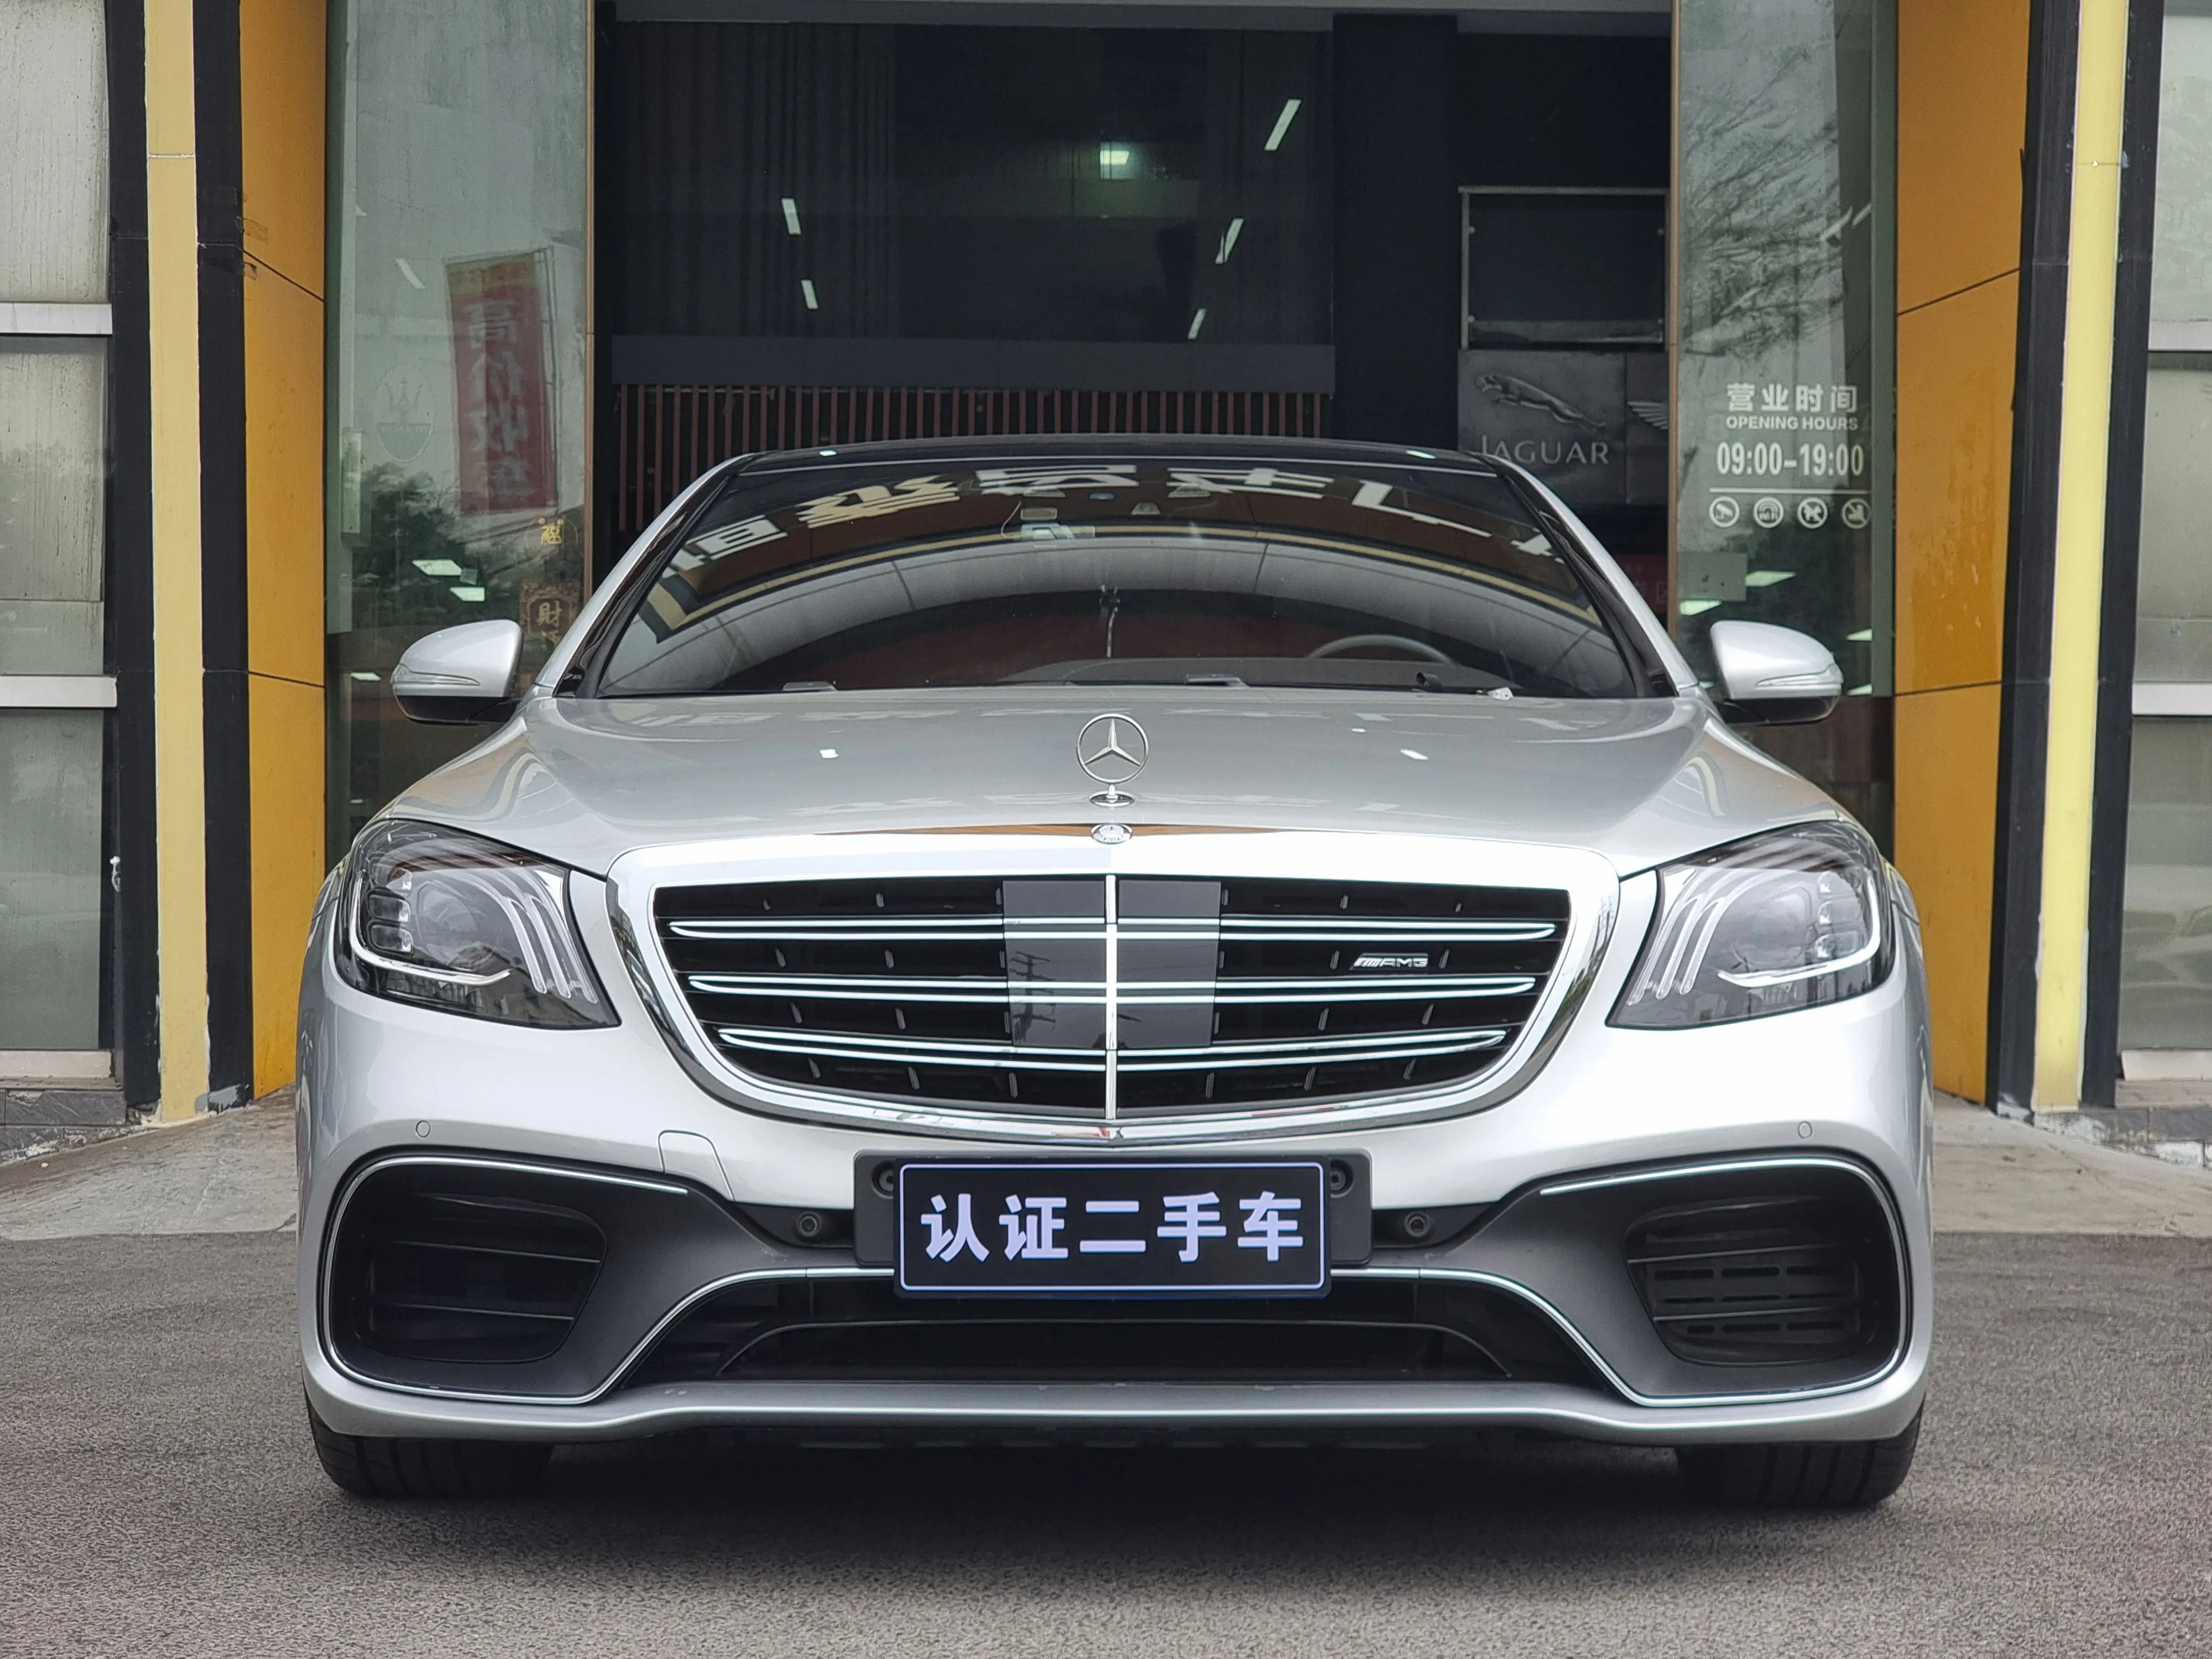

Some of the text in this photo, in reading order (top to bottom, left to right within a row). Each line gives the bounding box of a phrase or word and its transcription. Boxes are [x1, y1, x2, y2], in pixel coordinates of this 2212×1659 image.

[1726, 383, 1858, 413] 营业时间
[1726, 416, 1859, 430] OPENING HOURS
[1482, 435, 1609, 465] JAGUAR
[1717, 442, 1864, 476] 09:00-19:00
[1379, 957, 1428, 968] AMG
[920, 1191, 1304, 1263] 认证二手车
